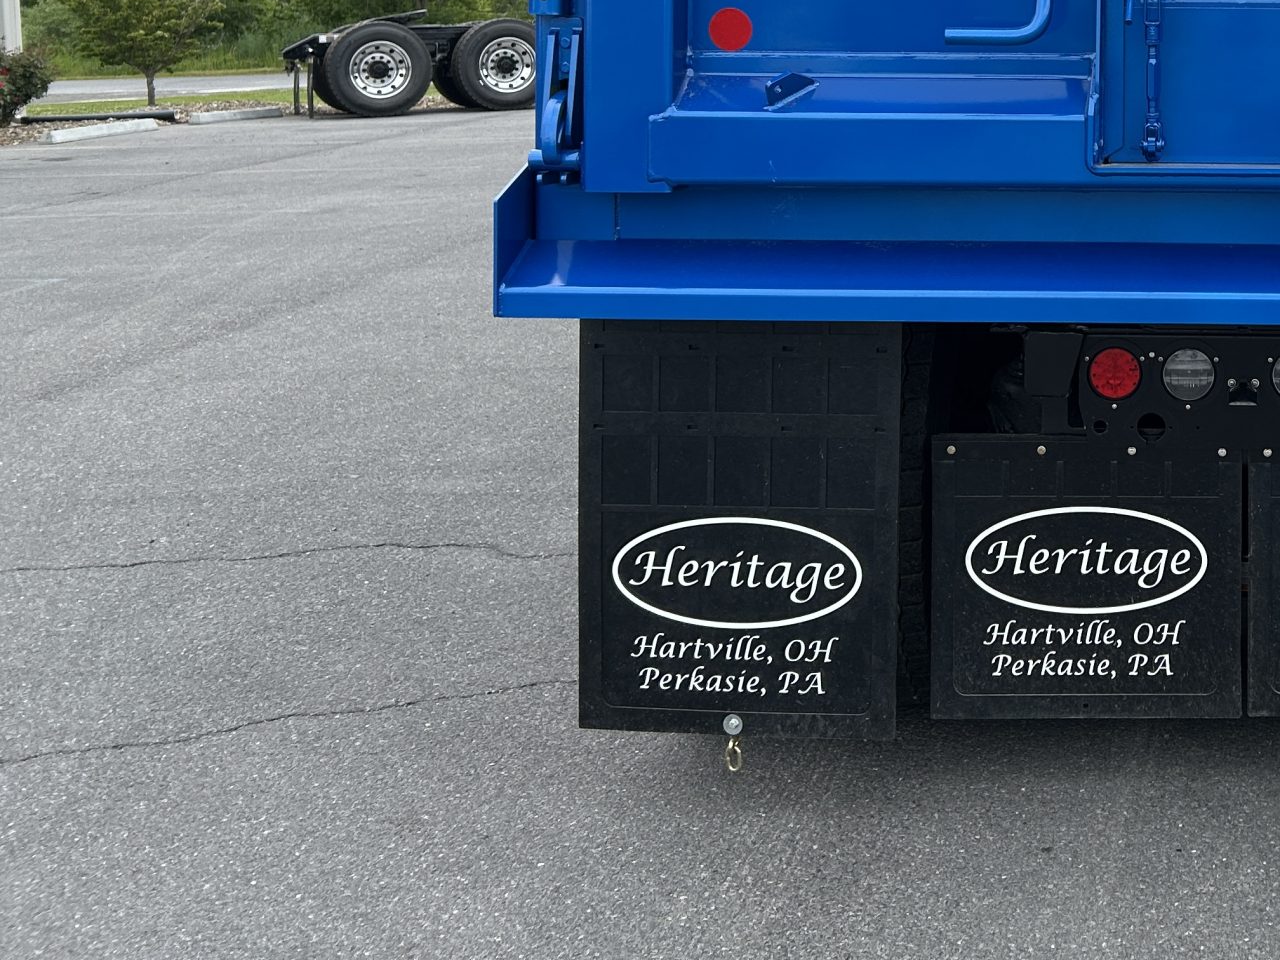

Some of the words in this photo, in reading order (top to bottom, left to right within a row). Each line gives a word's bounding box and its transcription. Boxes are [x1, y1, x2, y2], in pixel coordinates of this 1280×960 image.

[628, 546, 846, 604] Heritage
[981, 534, 1191, 589] Heritage
[630, 633, 773, 665] Hartville,
[784, 637, 839, 663] OH
[983, 620, 1122, 648] Hartville,
[1133, 619, 1186, 646] OH
[991, 651, 1117, 680] Perkasie,
[1127, 653, 1174, 676] PA
[638, 666, 767, 697] Perkasie,
[778, 670, 826, 695] PA
